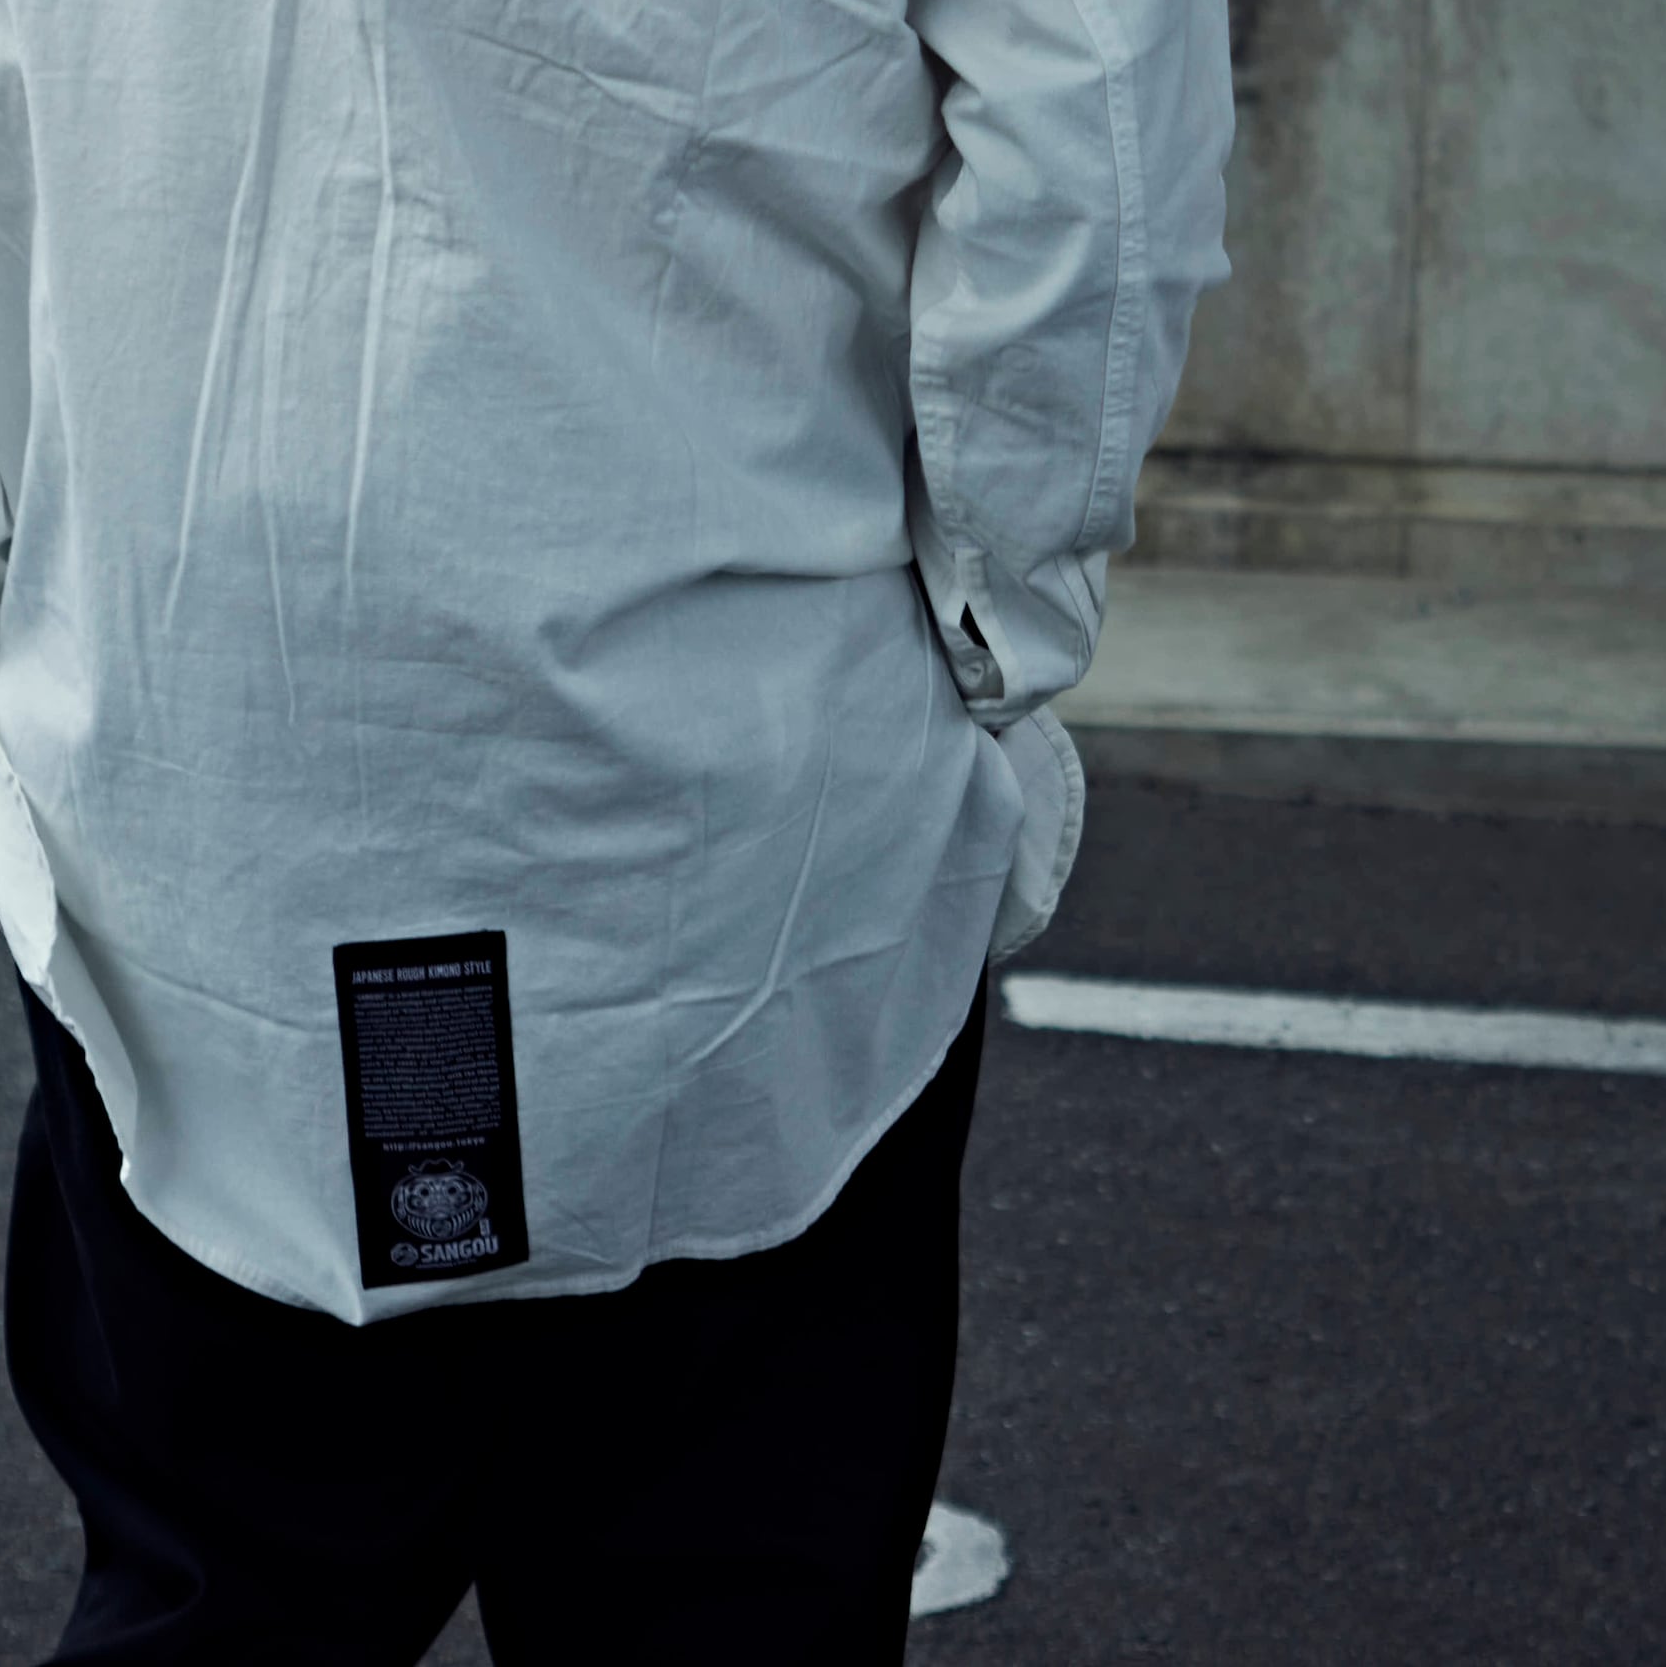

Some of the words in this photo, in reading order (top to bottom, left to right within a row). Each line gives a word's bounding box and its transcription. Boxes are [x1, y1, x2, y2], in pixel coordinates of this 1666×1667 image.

[352, 968, 394, 985] JAPANESE
[396, 966, 426, 981] ROUGH
[428, 962, 461, 979] KIMONO
[464, 960, 492, 976] STYLE
[420, 1235, 499, 1263] SANGOU
